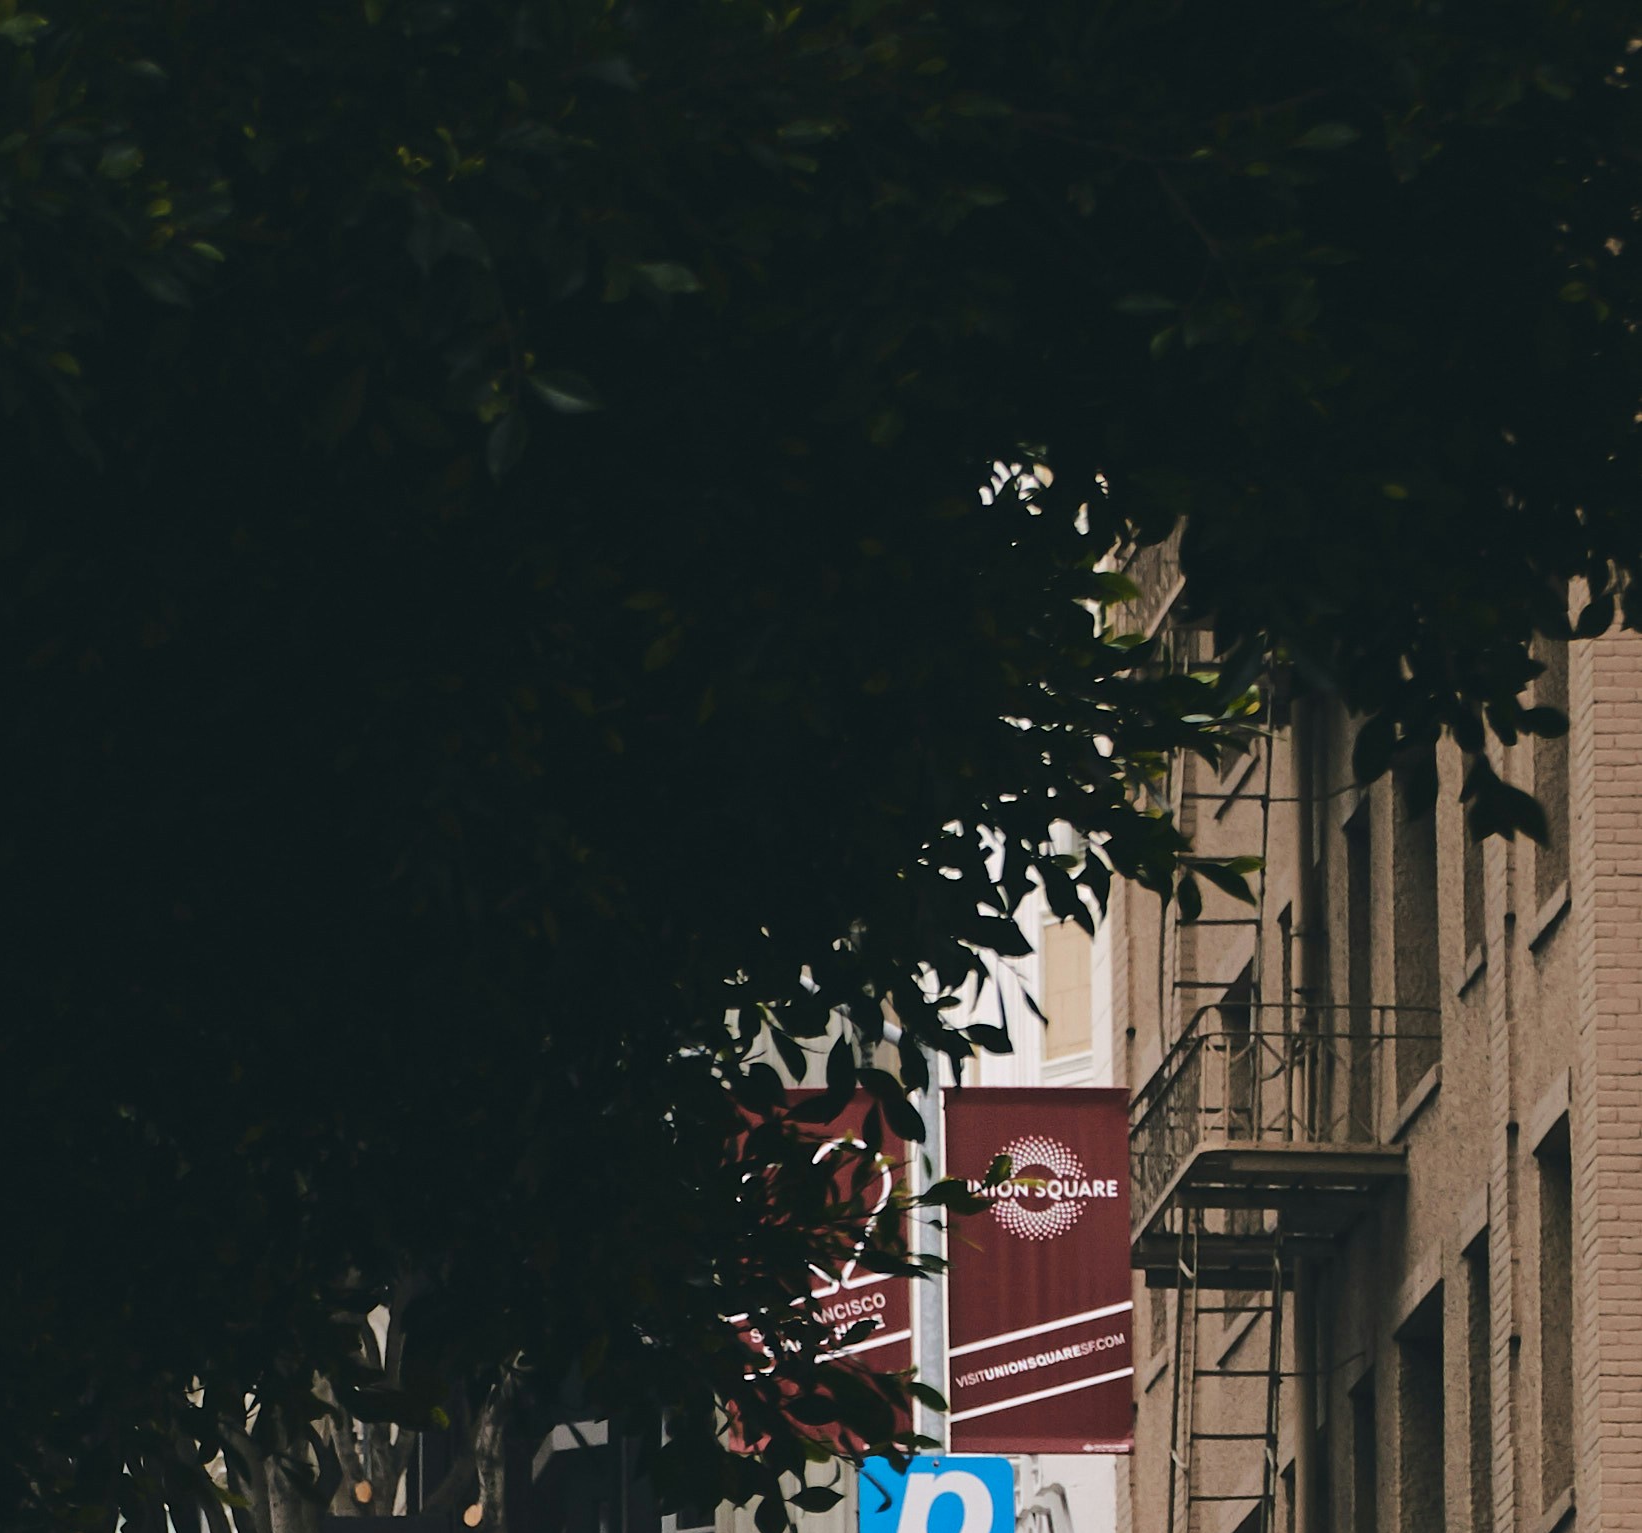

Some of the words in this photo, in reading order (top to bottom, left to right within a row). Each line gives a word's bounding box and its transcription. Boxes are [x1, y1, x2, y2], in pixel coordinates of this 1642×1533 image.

[1034, 1179, 1119, 1201] SQUARE
[812, 1292, 886, 1324] NCISCO
[955, 1332, 1126, 1388] VISITUNIONSQUARESF.COM
